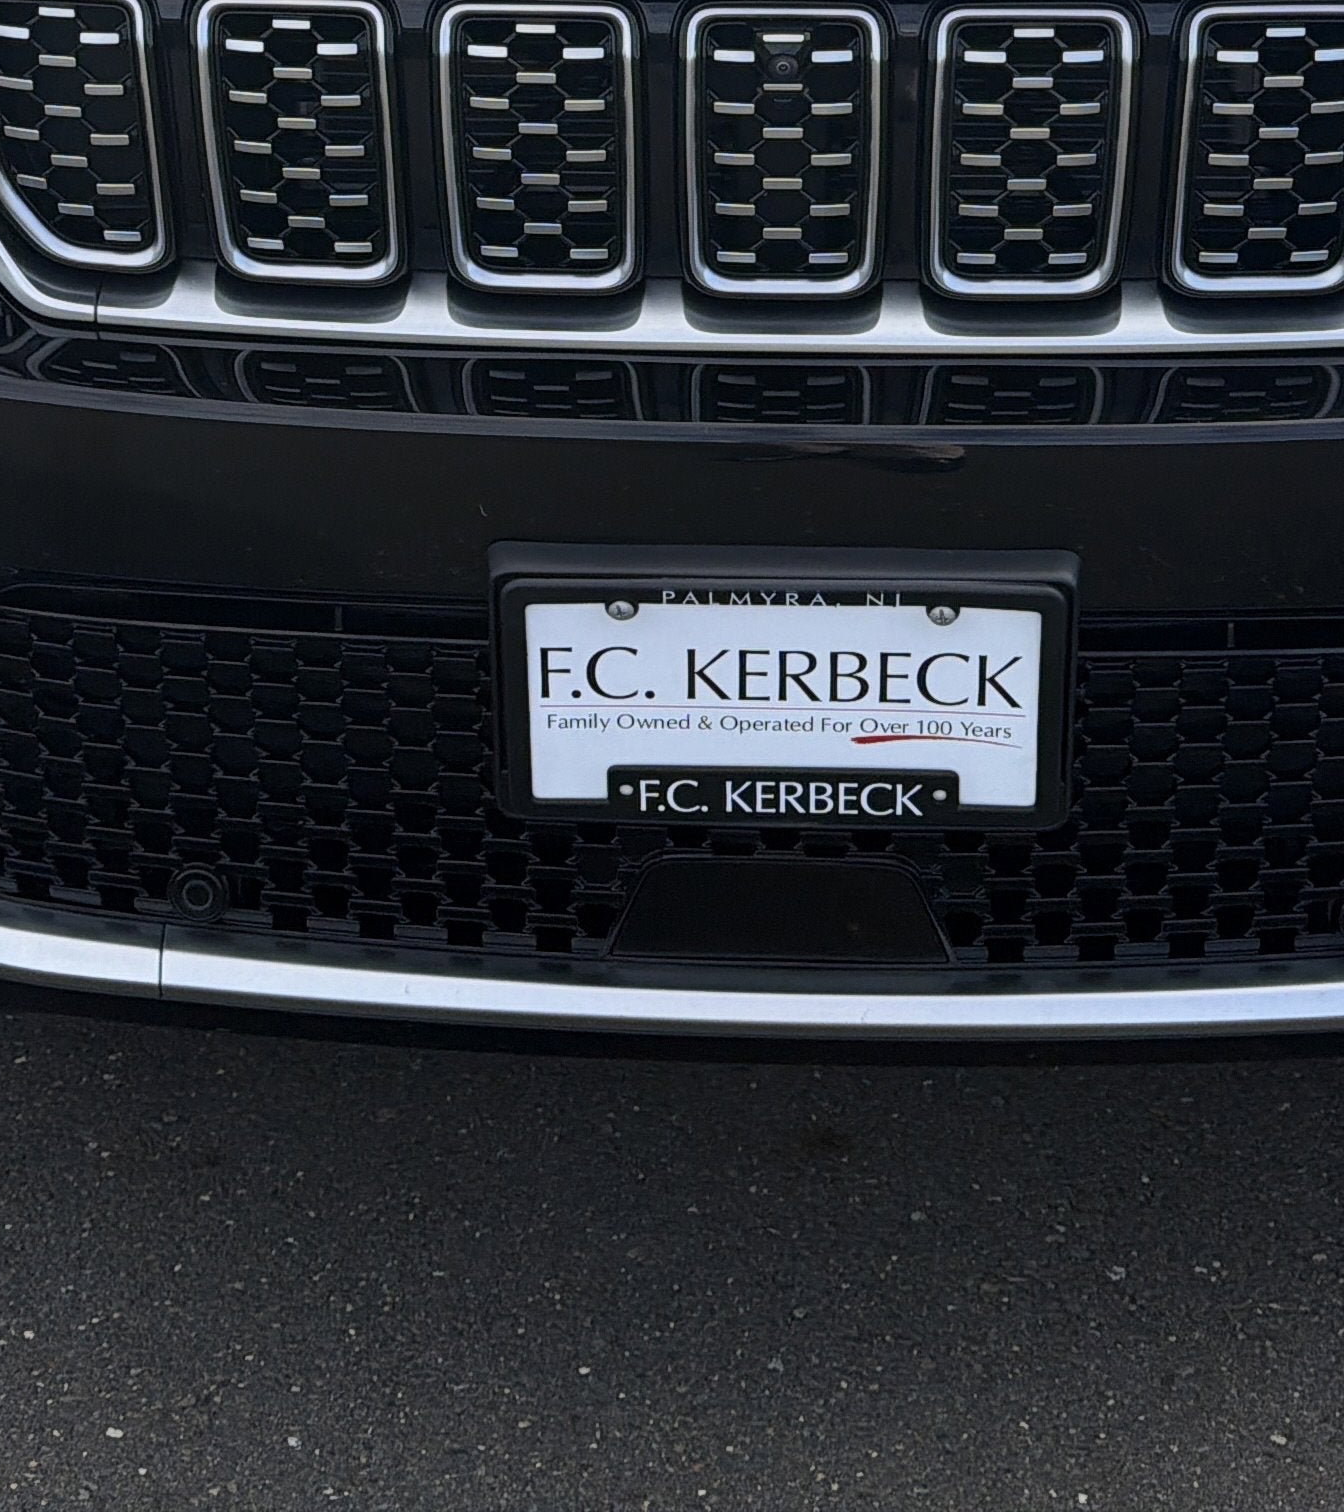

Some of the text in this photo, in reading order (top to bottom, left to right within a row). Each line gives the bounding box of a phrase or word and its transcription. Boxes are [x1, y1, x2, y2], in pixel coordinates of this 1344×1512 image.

[540, 646, 1023, 709] F.C. KERBECK
[547, 713, 1012, 739] Family Owned & Operated For Over 100 Years
[639, 779, 923, 817] F.C. KERBECK
